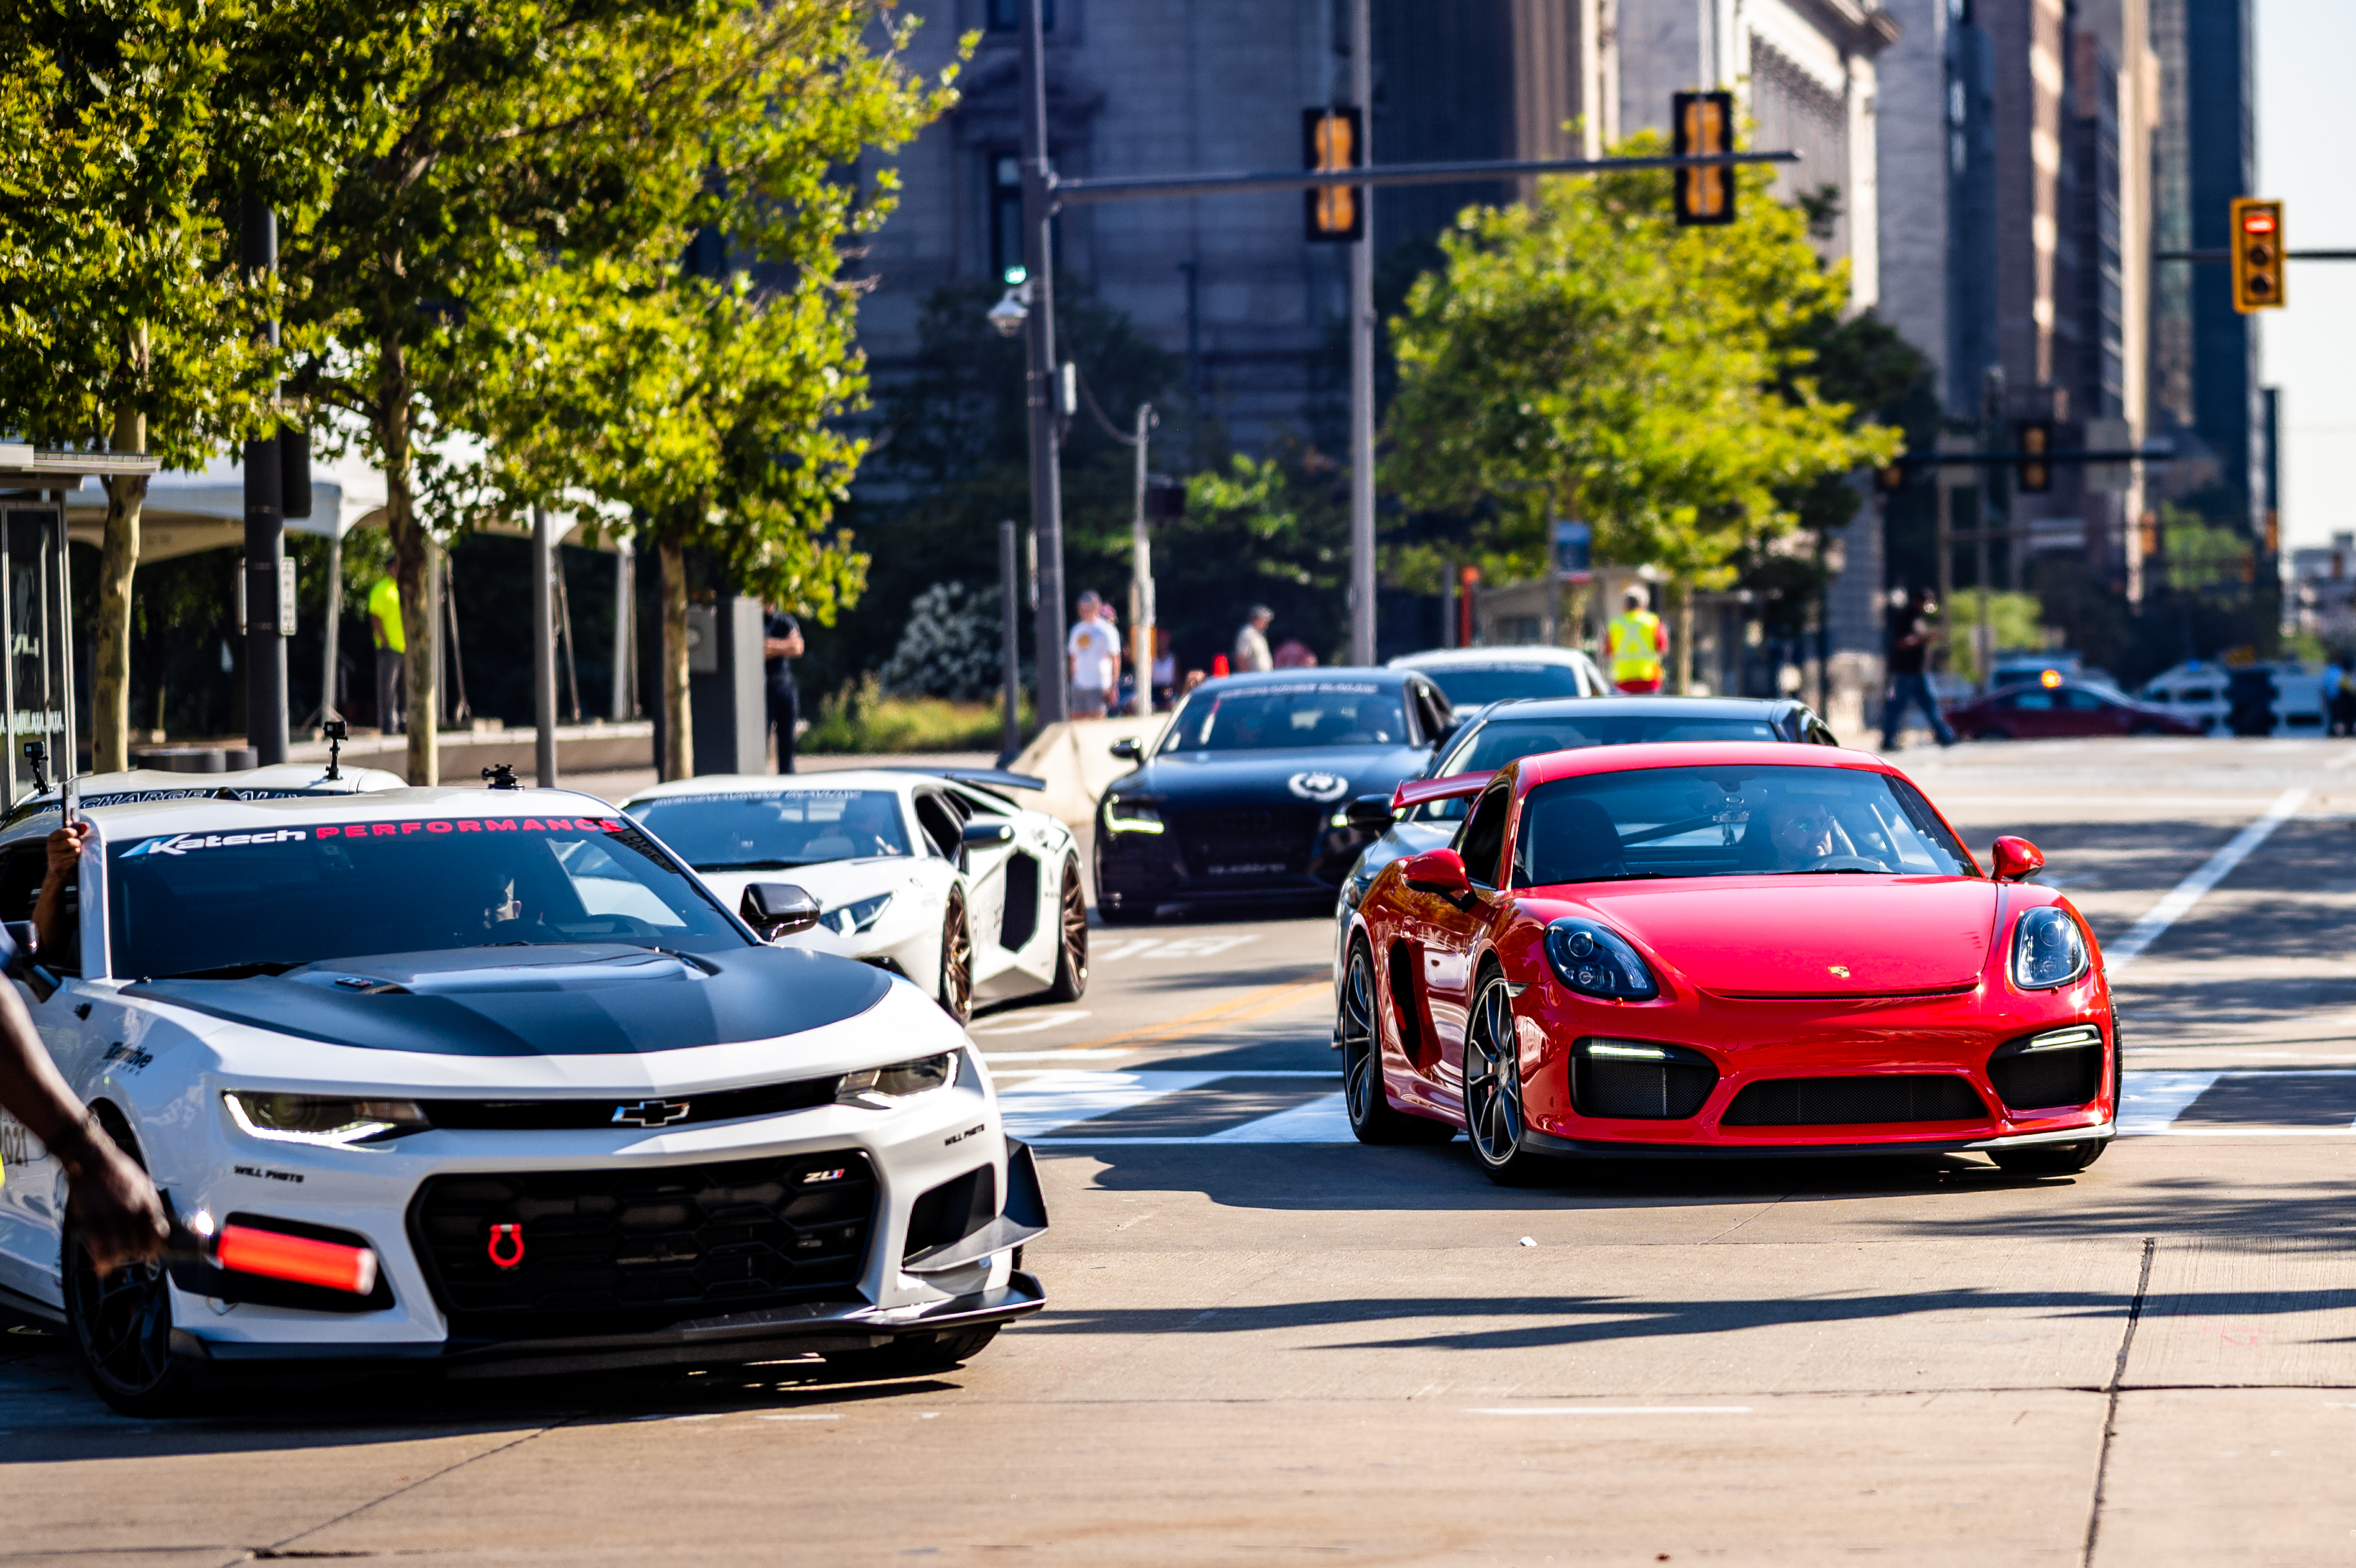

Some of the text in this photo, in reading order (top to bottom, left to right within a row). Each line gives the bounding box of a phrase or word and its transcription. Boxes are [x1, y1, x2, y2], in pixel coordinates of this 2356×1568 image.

[148, 818, 624, 855] Katech PERFORMANCE
[803, 1168, 845, 1184] ZL1
